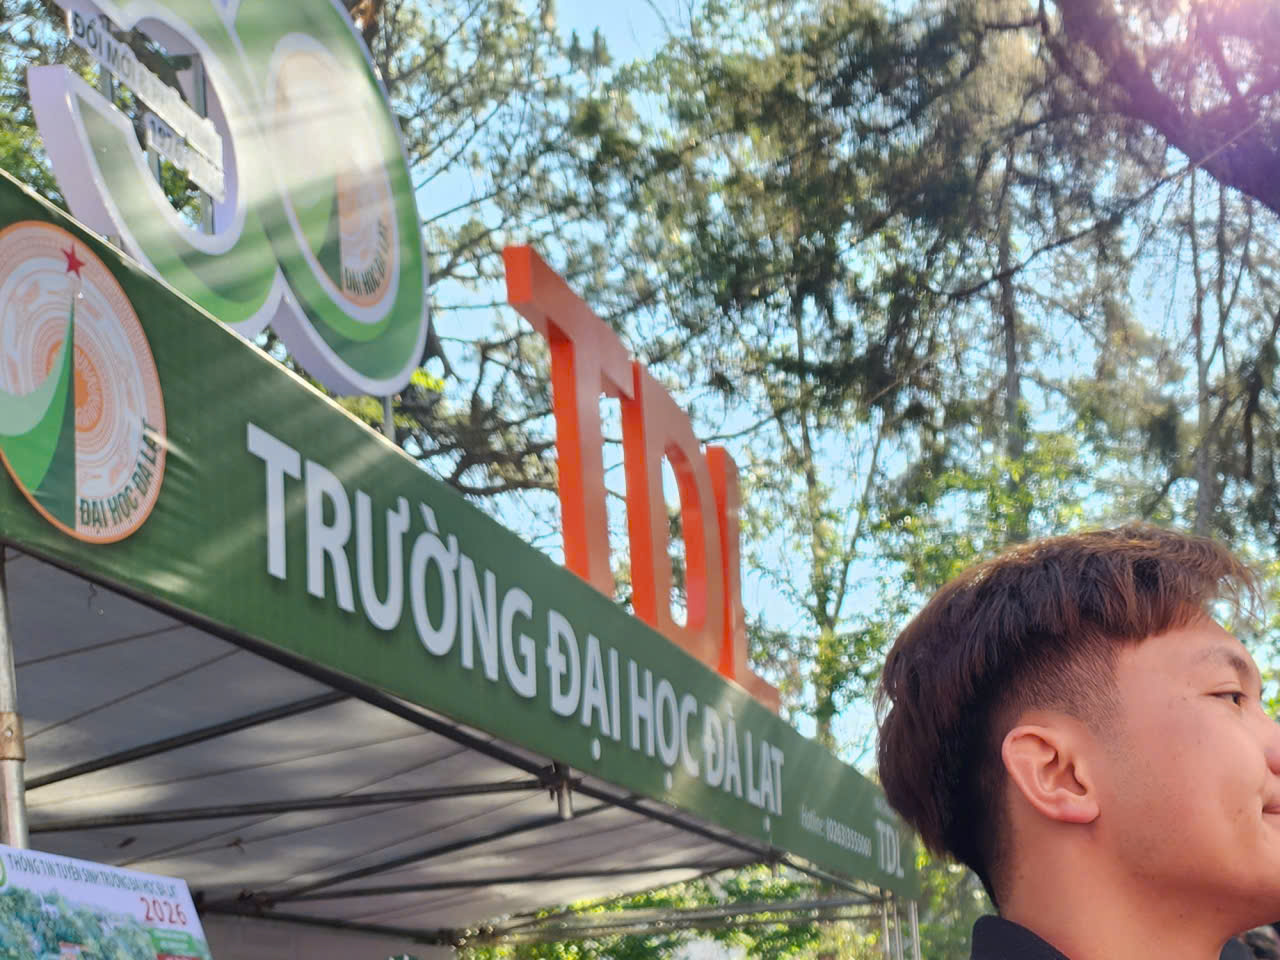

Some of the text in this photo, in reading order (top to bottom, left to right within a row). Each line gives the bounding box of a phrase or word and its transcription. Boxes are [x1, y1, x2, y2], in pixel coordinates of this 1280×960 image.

[79, 497, 108, 535] ĐẠI
[246, 421, 785, 833] TRƯỜNG ĐẠI HỌC ĐÀ LẠT
[7, 852, 41, 876] THÔNG
[140, 896, 188, 926] 2026
